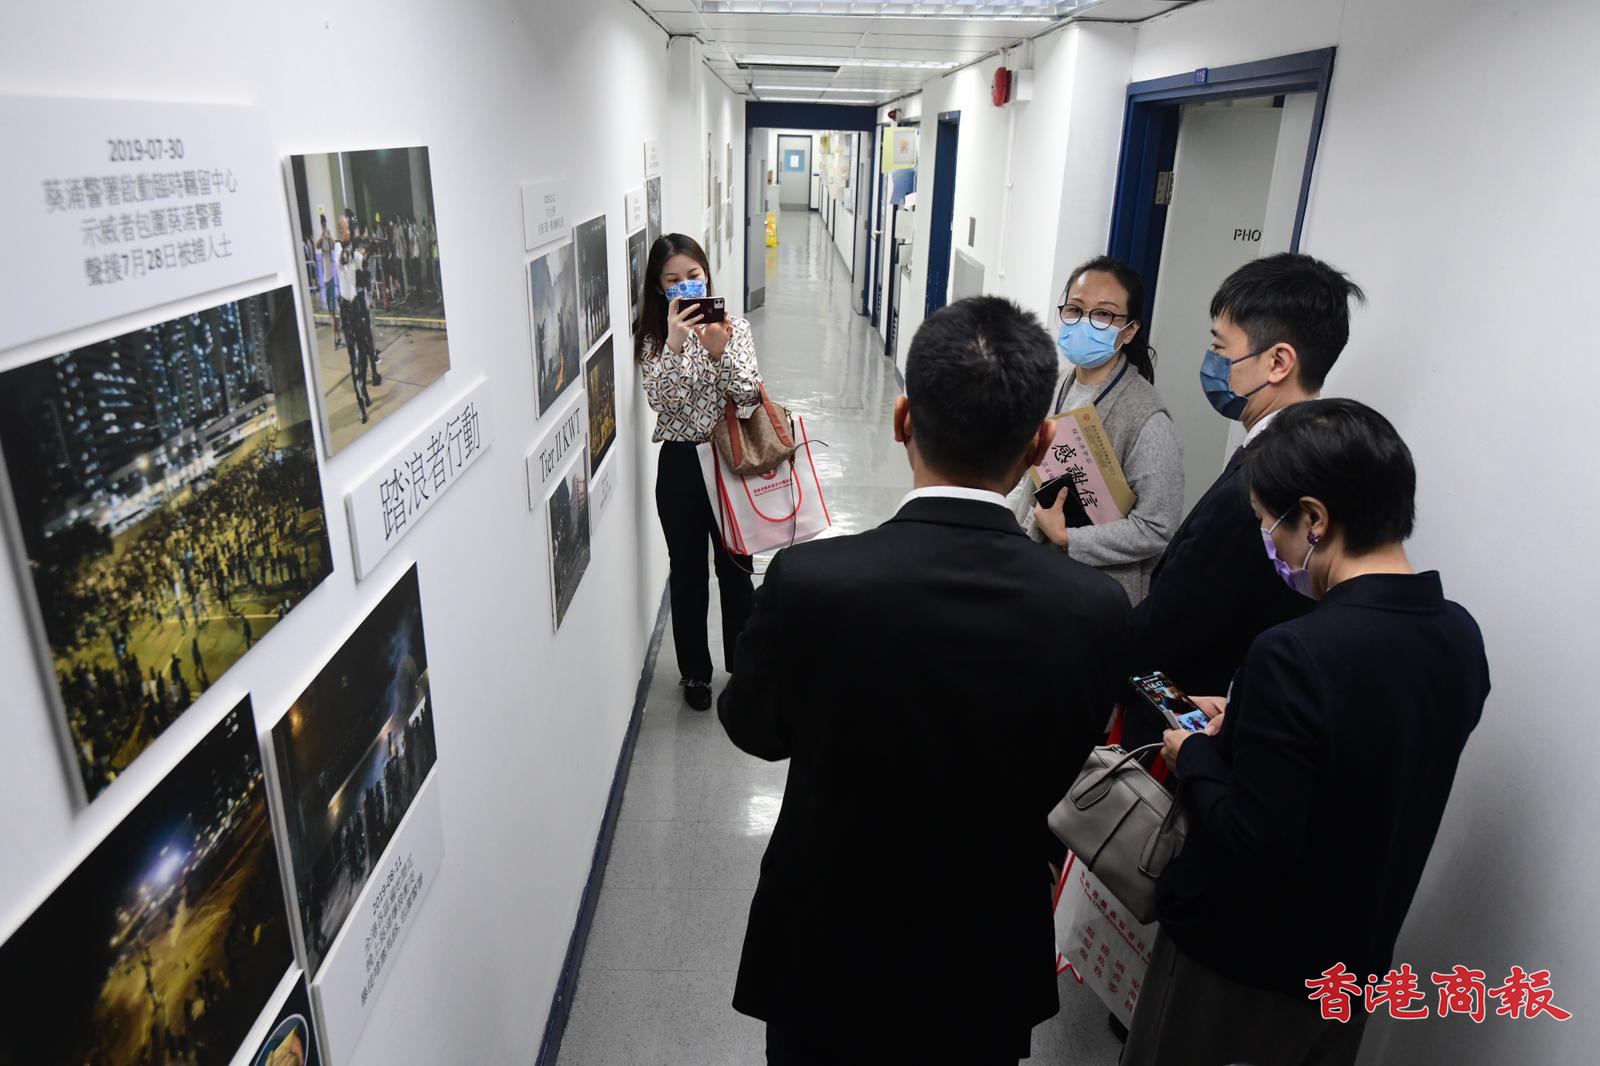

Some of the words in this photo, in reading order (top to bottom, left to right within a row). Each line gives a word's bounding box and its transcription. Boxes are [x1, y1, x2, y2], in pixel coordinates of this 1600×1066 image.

[108, 138, 184, 162] 2019-07-30
[81, 201, 223, 248] 示威者包圍葵涌警署
[1233, 228, 1262, 242] PHO
[84, 233, 233, 287] 聲援7月28日被捕人士
[379, 401, 481, 541] 踏浪者行動
[539, 448, 555, 483] Tier
[1051, 443, 1098, 508] 感謝信
